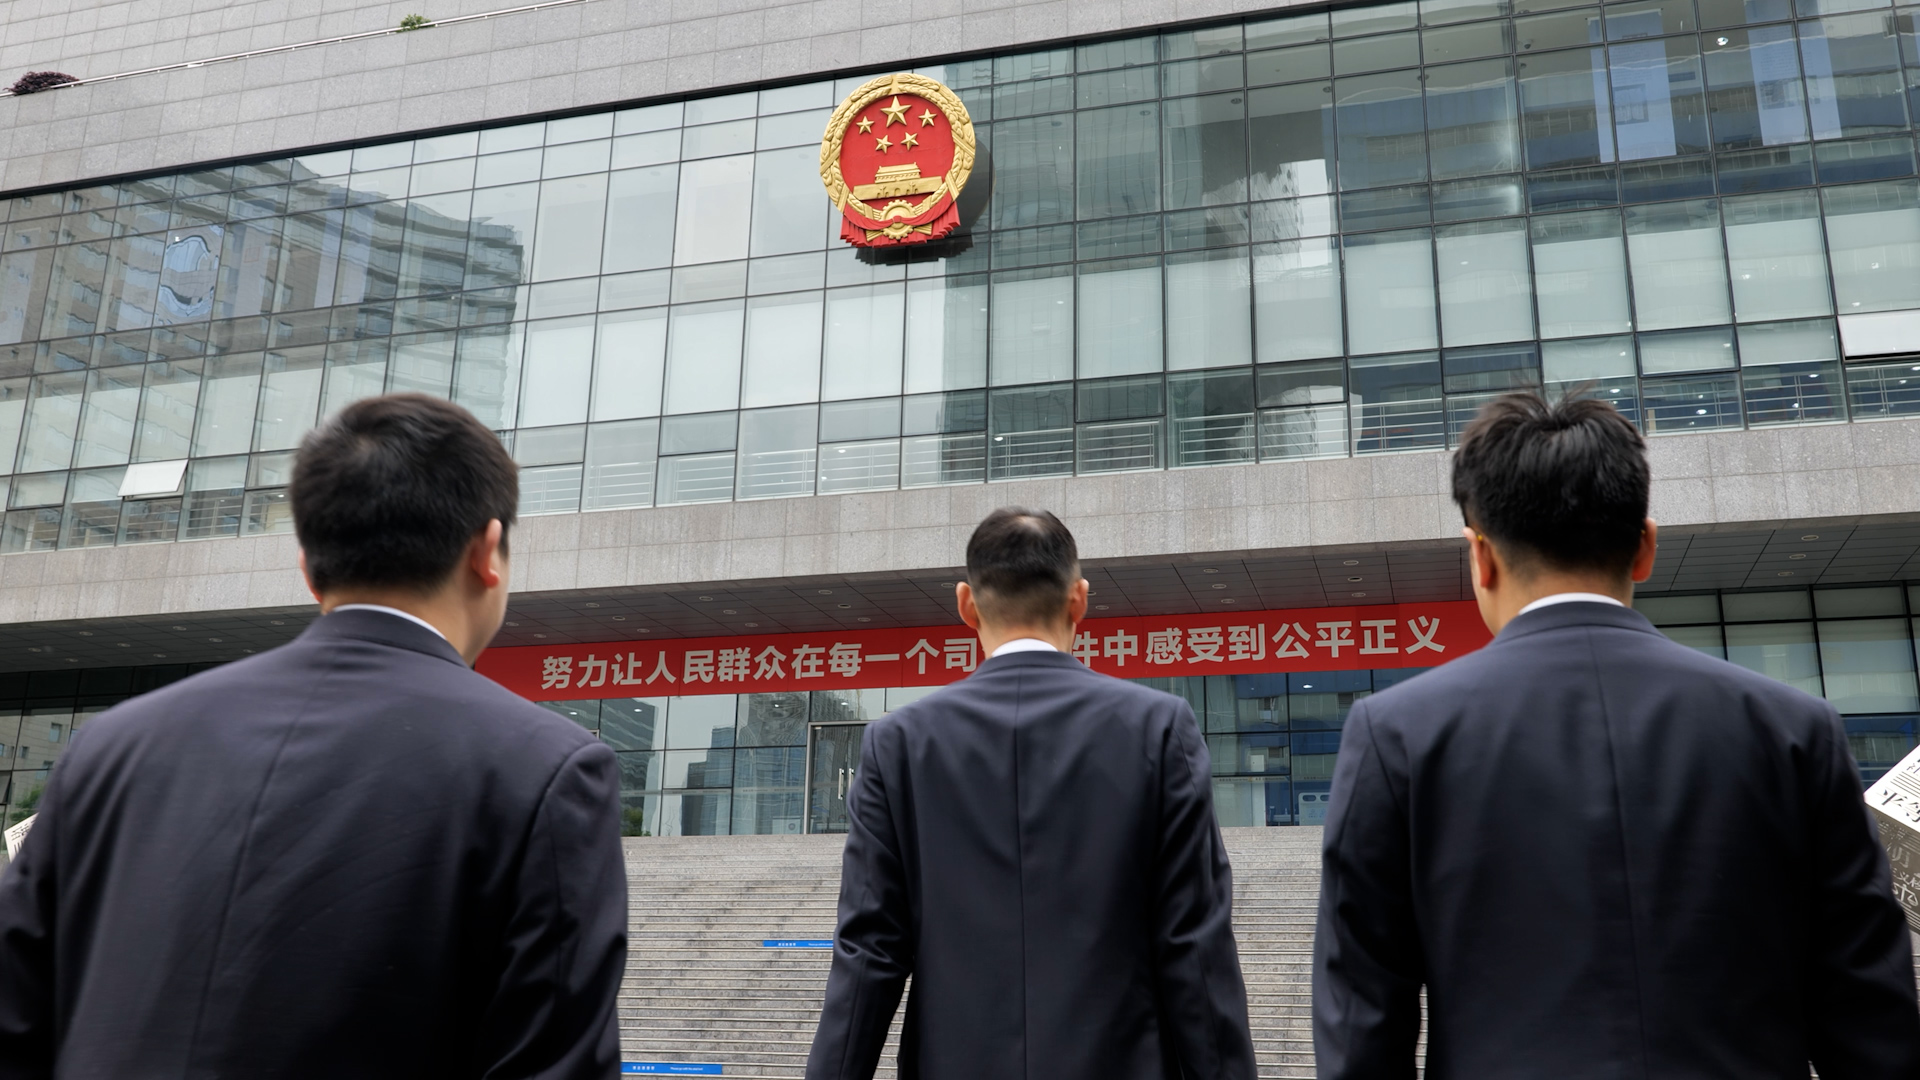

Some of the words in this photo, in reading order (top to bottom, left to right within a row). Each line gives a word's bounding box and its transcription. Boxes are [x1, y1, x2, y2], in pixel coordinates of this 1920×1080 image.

[541, 615, 1446, 690] 努力让人民群众在每一个司件中感受到公平正义
